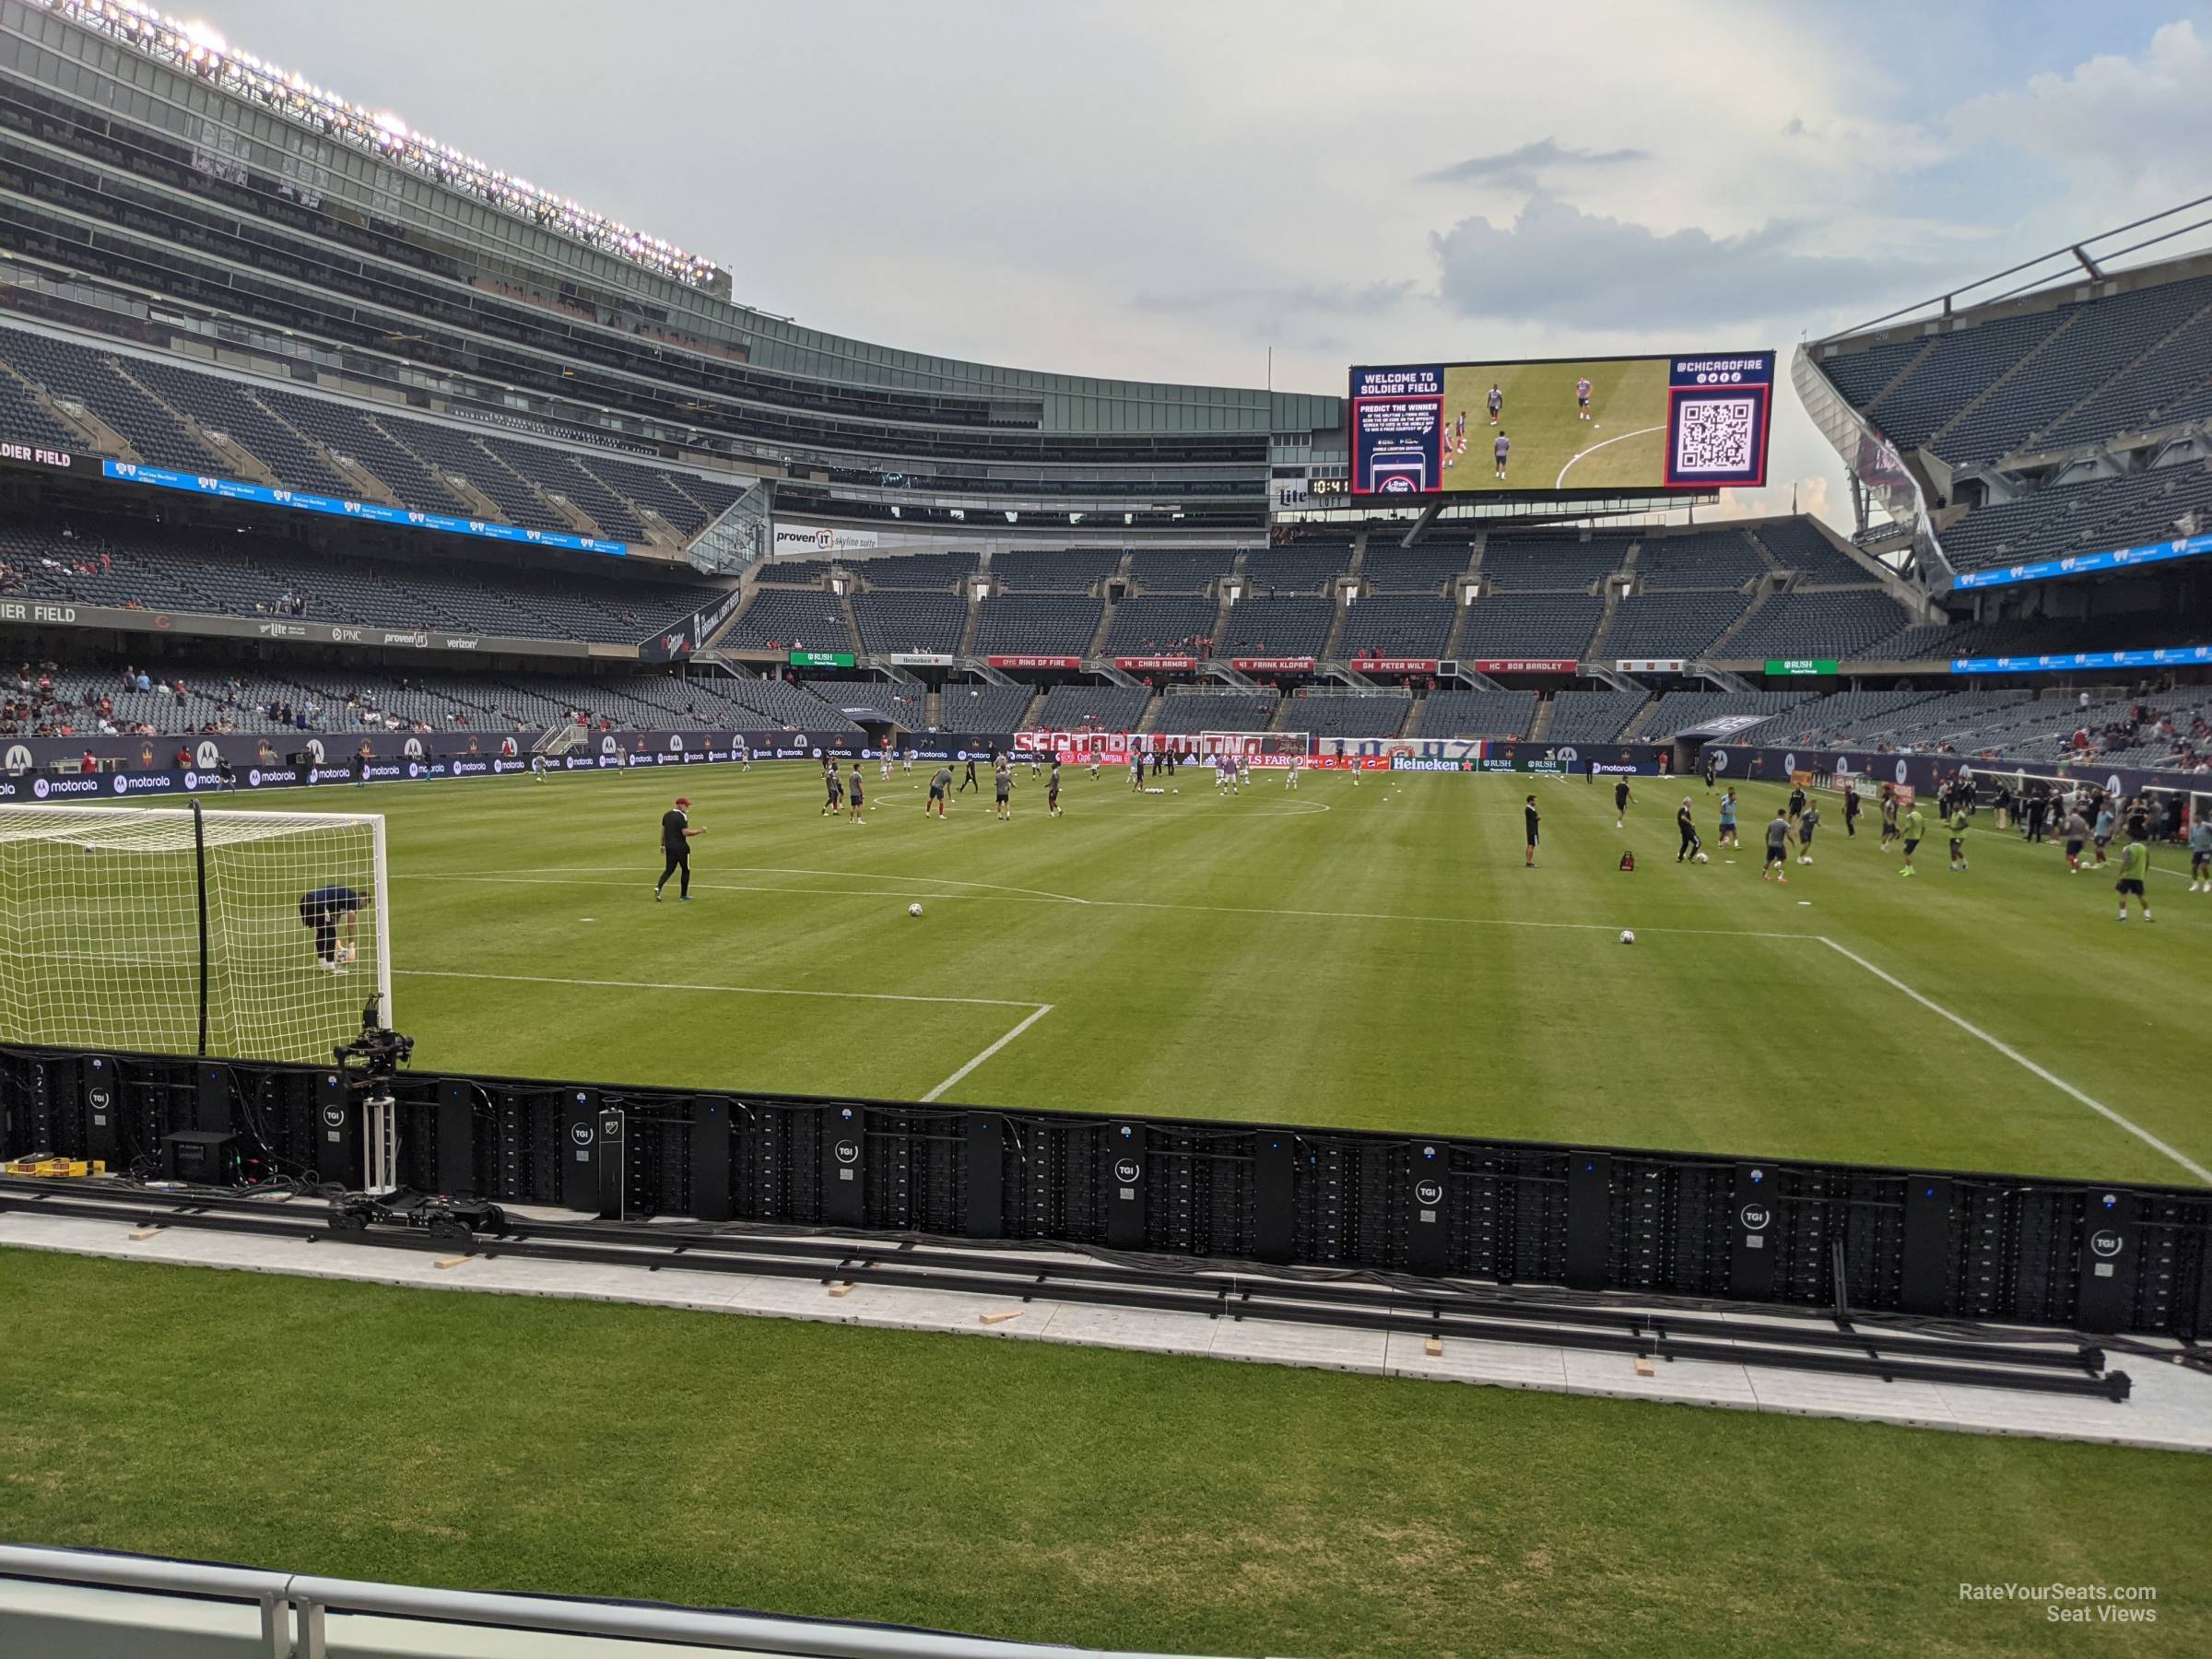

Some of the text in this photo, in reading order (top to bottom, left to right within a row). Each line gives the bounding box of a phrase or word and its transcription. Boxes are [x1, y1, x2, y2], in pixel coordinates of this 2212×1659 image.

[1677, 359, 1762, 372] @CHICAGOFIRE
[1365, 372, 1433, 384] WELCOME TO
[1360, 382, 1438, 394] SOLDIER FIELD
[35, 449, 71, 467] FIELD
[1313, 479, 1348, 494] 10:41
[1279, 488, 1307, 507] Lite
[1319, 497, 1343, 507] LOFT
[776, 532, 877, 548] proven IT skyline suite
[34, 606, 76, 623] FIELD
[270, 622, 287, 637] Lite
[343, 630, 362, 641] PNC
[384, 633, 414, 644] proven
[447, 638, 476, 650] verizon
[1362, 662, 1374, 670] GM
[635, 754, 653, 763] motorola
[663, 753, 679, 761] motorola
[688, 752, 704, 760] motorola
[712, 751, 728, 759] motorola
[758, 749, 772, 758] motorola
[828, 749, 852, 758] otorola
[919, 750, 947, 759] motorola
[968, 751, 991, 759] motoro
[1100, 751, 1123, 764] Morgan
[462, 761, 487, 771] motorola
[501, 759, 524, 769] motorola
[573, 757, 594, 766] motorola
[1393, 758, 1459, 771] Heineken
[1535, 760, 1557, 769] RUSH
[318, 768, 350, 779] motorola
[371, 765, 400, 777] motorola
[1601, 764, 1637, 773] motorola
[128, 774, 171, 789] motorola
[262, 771, 296, 782] motorola
[51, 779, 98, 793] motorola
[326, 1112, 339, 1120] TGI
[575, 1129, 588, 1138] TGI
[839, 1147, 853, 1156] TGI
[1119, 1166, 1134, 1175] TGI
[1419, 1187, 1436, 1196] TGI
[1746, 1212, 1762, 1221] TGI
[2097, 1238, 2115, 1248] TGI
